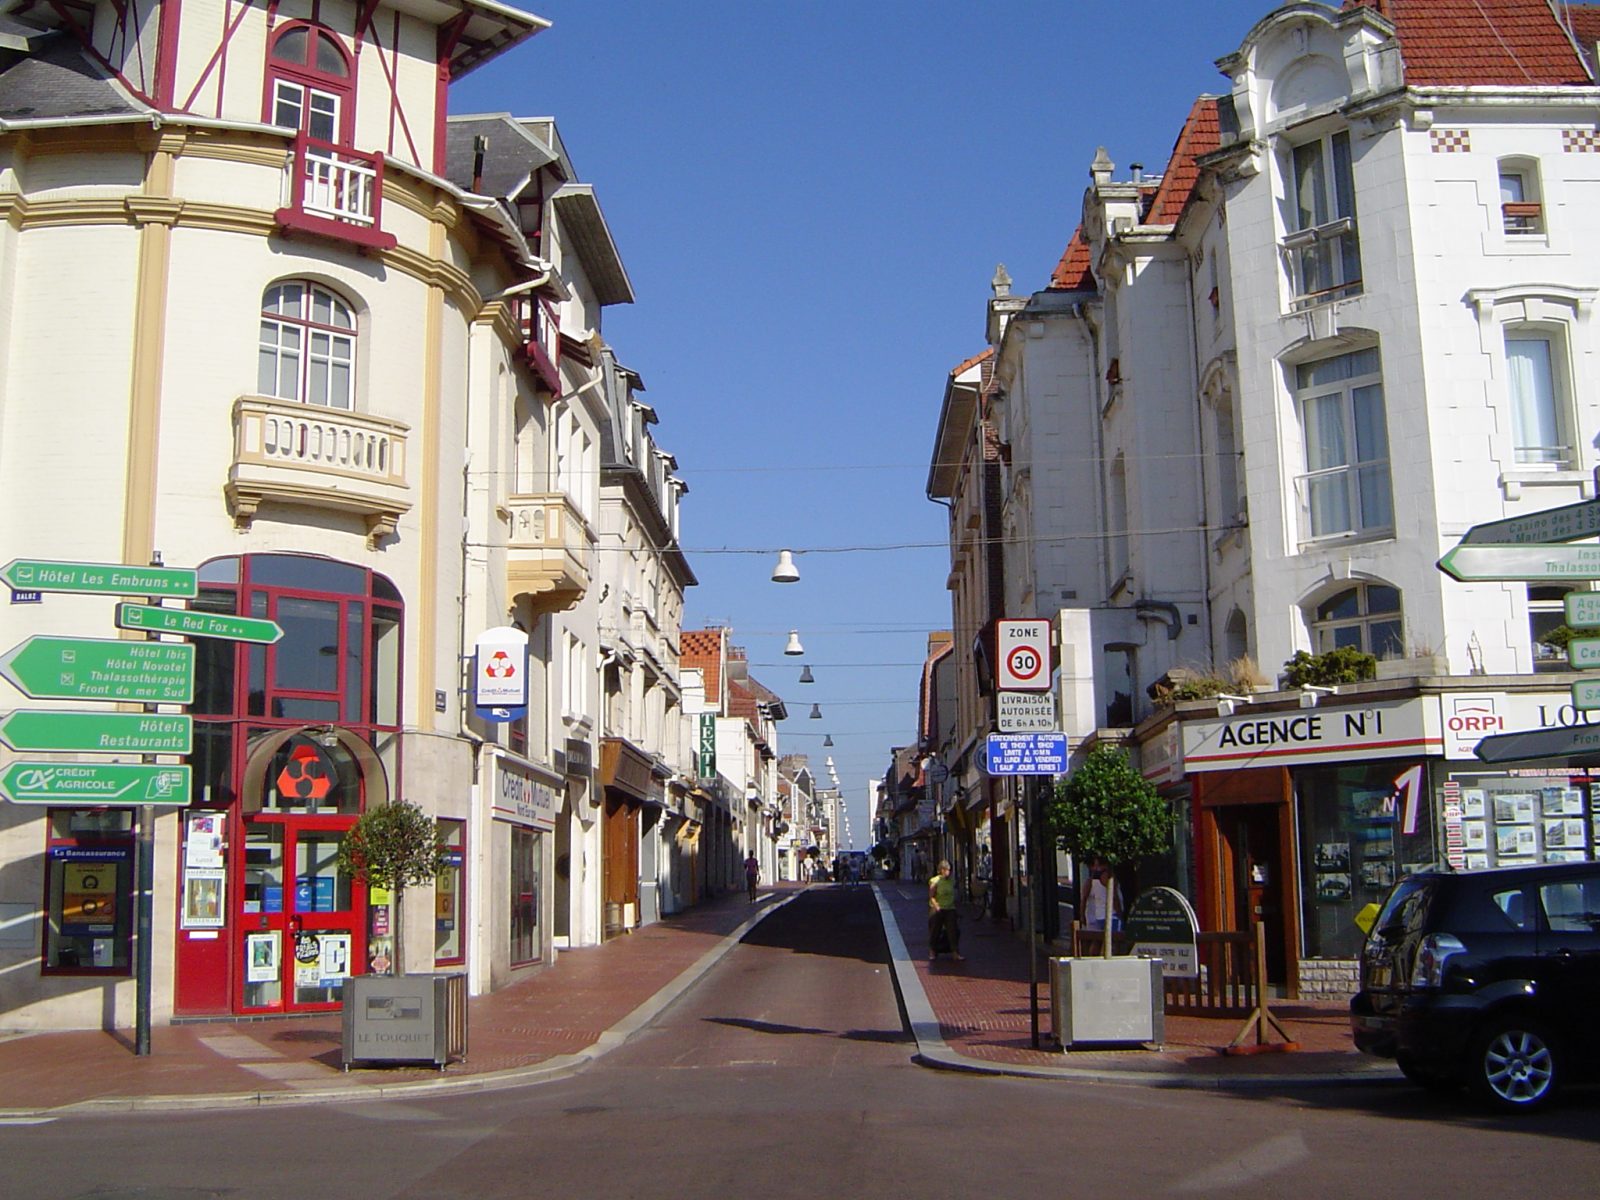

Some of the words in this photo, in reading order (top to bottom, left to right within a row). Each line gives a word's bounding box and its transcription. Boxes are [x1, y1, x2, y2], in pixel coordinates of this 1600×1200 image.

[1509, 519, 1547, 533] Casino
[1552, 514, 1570, 524] des
[1576, 509, 1582, 518] 4
[1516, 530, 1548, 543] Marin
[1552, 526, 1571, 536] des
[1577, 520, 1583, 529] 4
[39, 570, 75, 584] Hôtel
[82, 572, 103, 585] Les
[111, 574, 168, 588] Embruns
[164, 614, 176, 626] Le
[183, 617, 204, 629] Red
[209, 620, 228, 632] Fox
[1009, 628, 1039, 637] ZONE
[130, 647, 160, 658] Hôtel
[166, 650, 186, 660] Ibis
[106, 659, 137, 670] Hôtel
[142, 660, 186, 672] Novotel
[1014, 656, 1035, 669] 30
[91, 671, 186, 686] Thalassothérapie
[79, 683, 110, 694] Front
[116, 685, 129, 695] de
[136, 688, 157, 696] mer
[163, 687, 185, 697] Sud
[1001, 696, 1050, 704] LIVRAISON
[1001, 706, 1052, 715] AUTORISÉE
[140, 720, 184, 733] Hôtels
[1001, 719, 1013, 727] DE
[1016, 719, 1028, 727] 6h
[1029, 719, 1035, 727] A
[1038, 719, 1052, 727] 10h
[1448, 716, 1504, 731] ORPI
[1219, 717, 1322, 748] AGENCE
[100, 734, 184, 748] Restaurants
[702, 713, 714, 778] TEXTI
[55, 768, 97, 777] CRÉDIT
[55, 780, 116, 789] AGRICOLE
